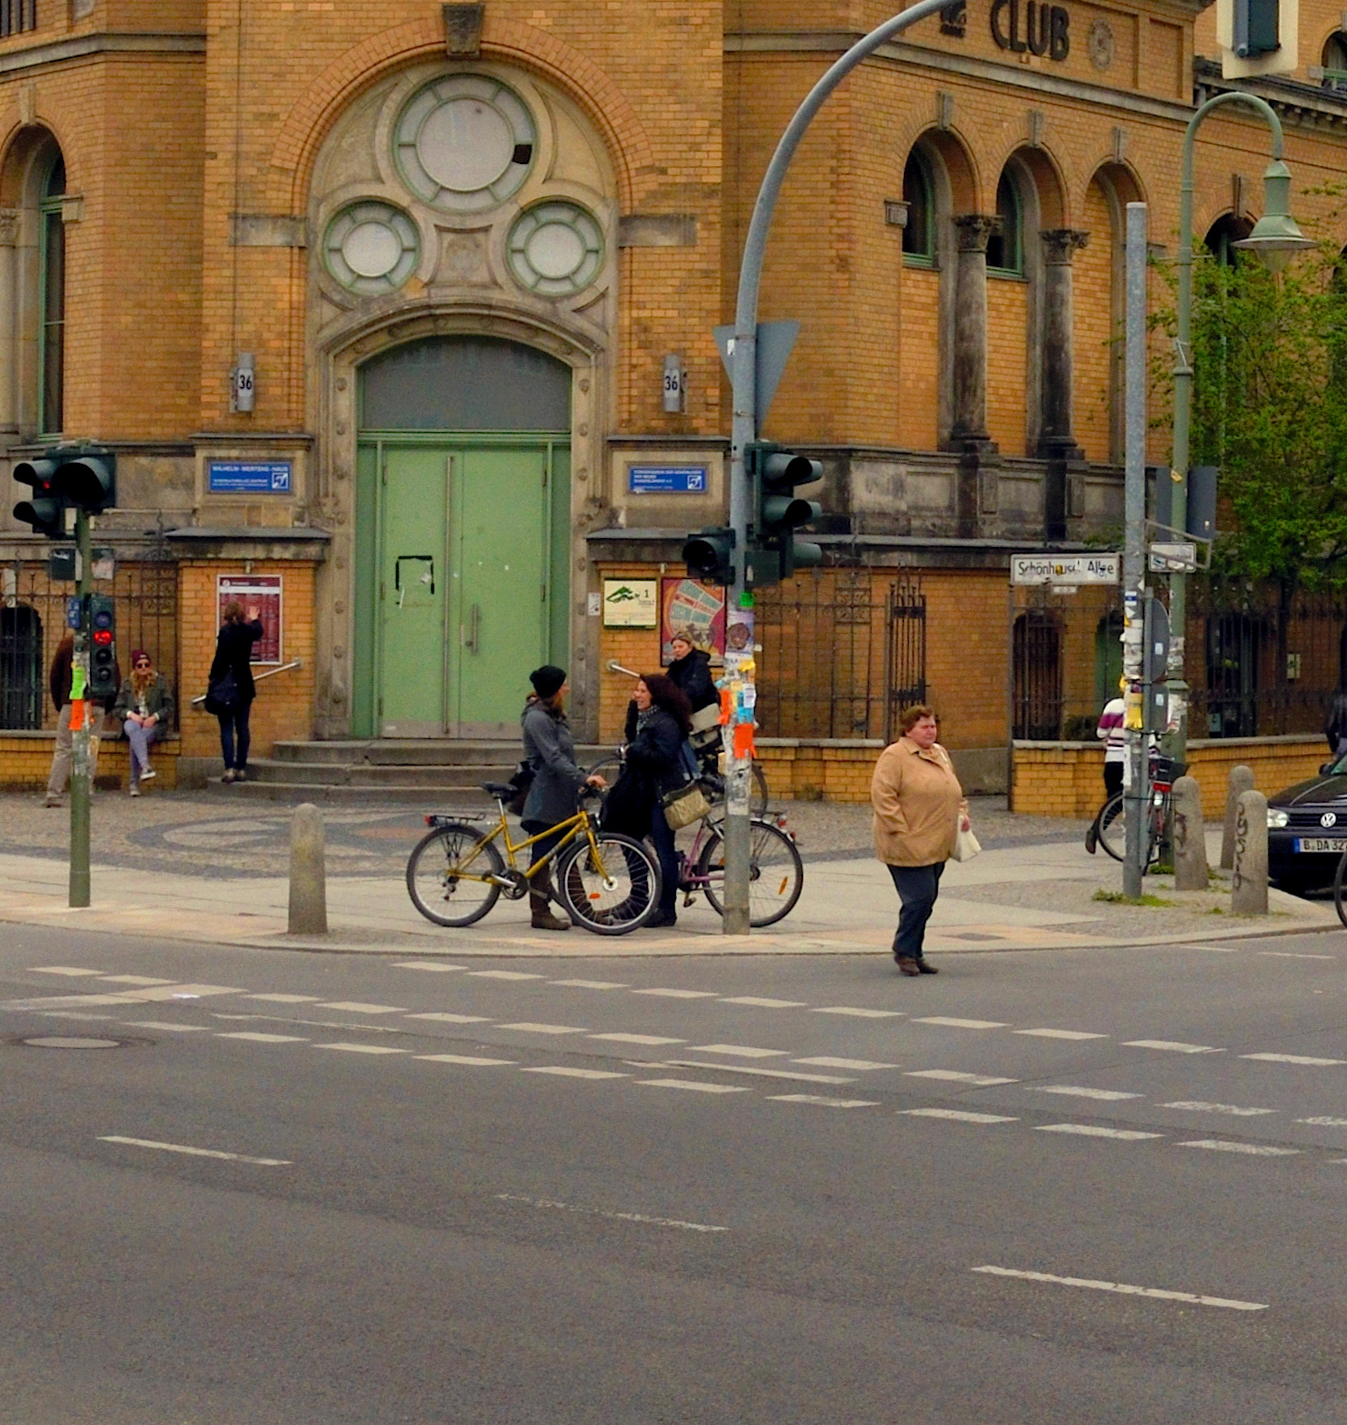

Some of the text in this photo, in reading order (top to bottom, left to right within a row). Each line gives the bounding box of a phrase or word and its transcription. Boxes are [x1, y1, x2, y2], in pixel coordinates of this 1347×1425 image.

[239, 374, 252, 390] 36
[664, 375, 679, 391] 36
[1303, 840, 1310, 850] B
[1316, 840, 1329, 851] DA
